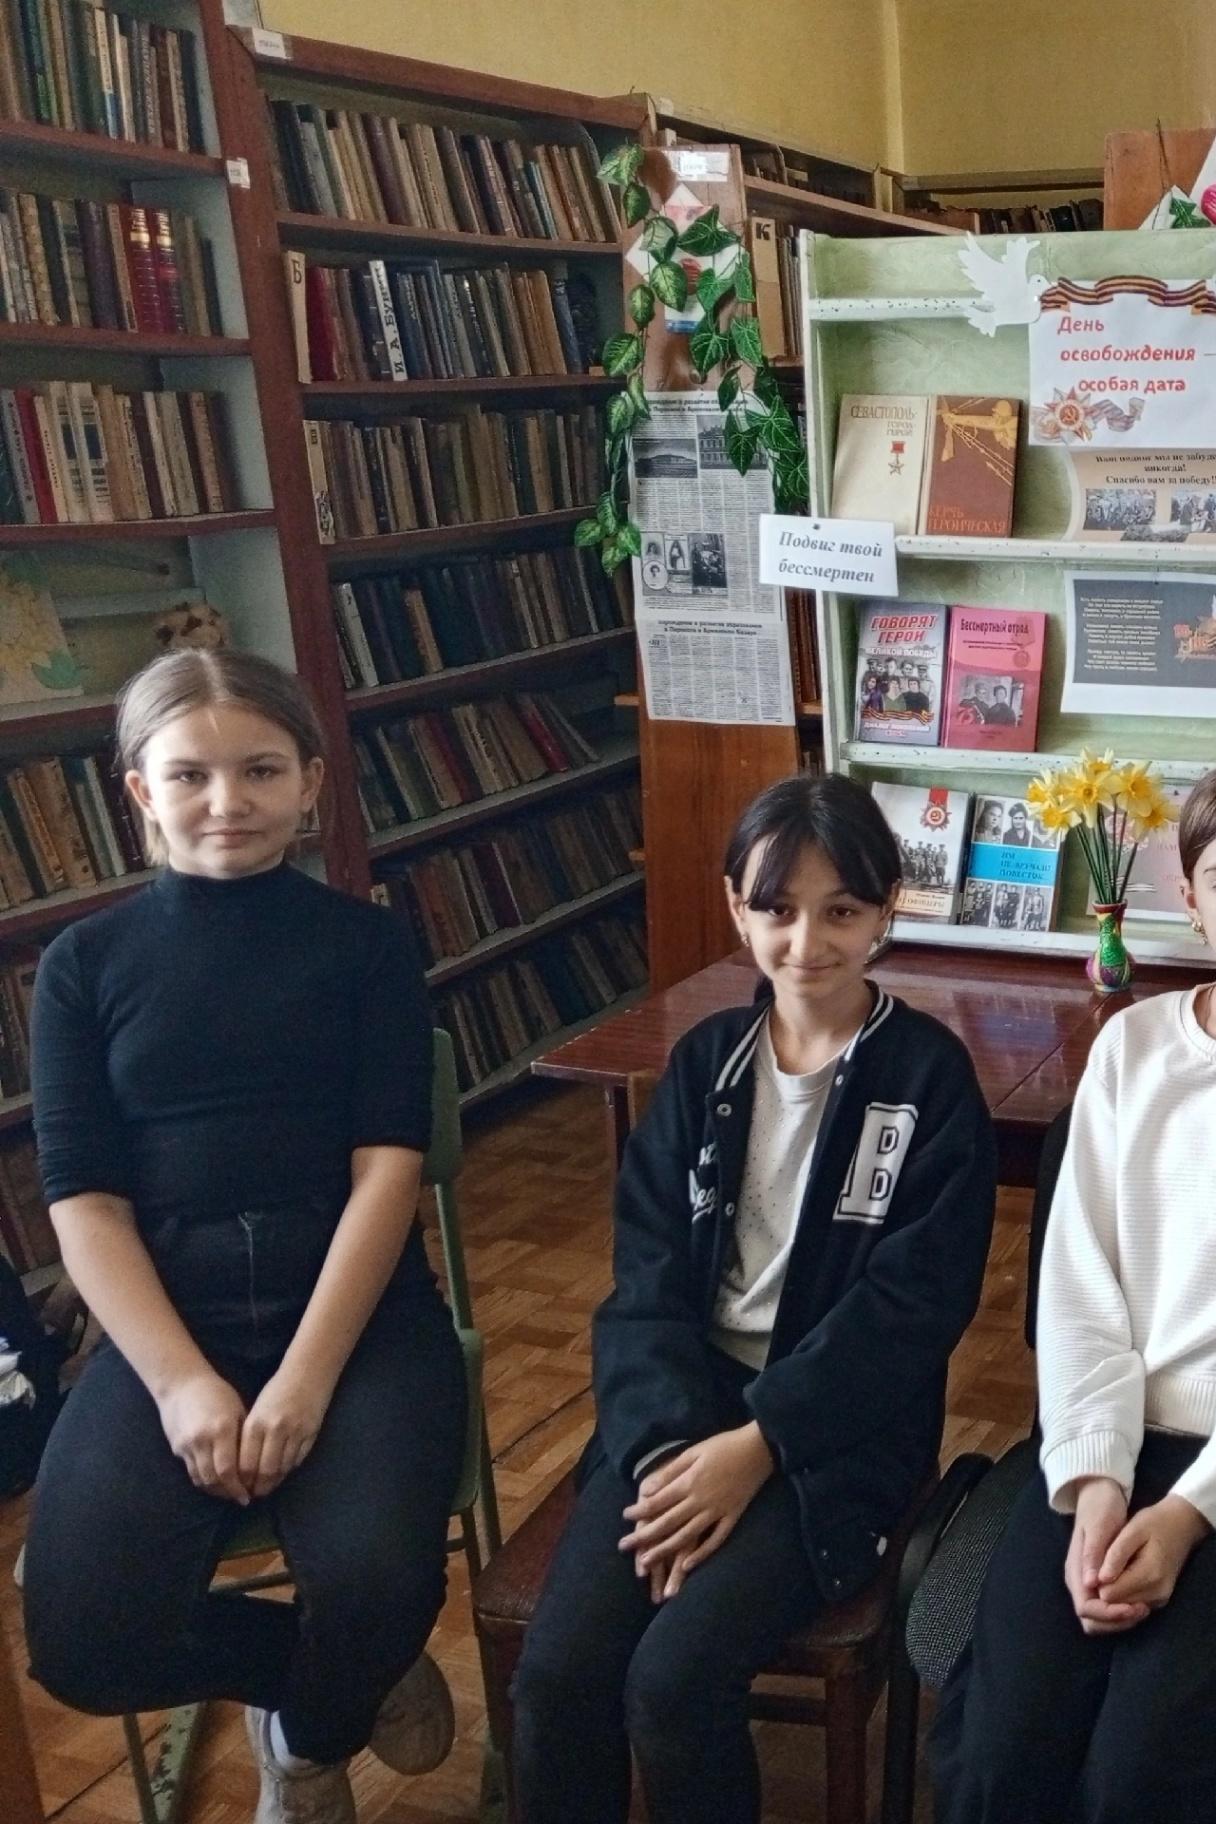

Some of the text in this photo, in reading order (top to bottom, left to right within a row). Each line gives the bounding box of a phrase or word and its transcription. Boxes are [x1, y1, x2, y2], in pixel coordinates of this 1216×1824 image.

[1058, 316, 1105, 335] День
[1060, 344, 1196, 362] освобождения
[1078, 376, 1186, 395] особая дата
[1144, 463, 1187, 473] никогда!
[1106, 475, 1146, 485] Спасибо
[779, 530, 883, 558] Подвиг твой
[778, 557, 875, 583] бессмертен
[871, 614, 937, 632] ГОВОРЯТ
[960, 618, 1007, 635] Бессмертный
[878, 629, 926, 644] ГЕРОИ
